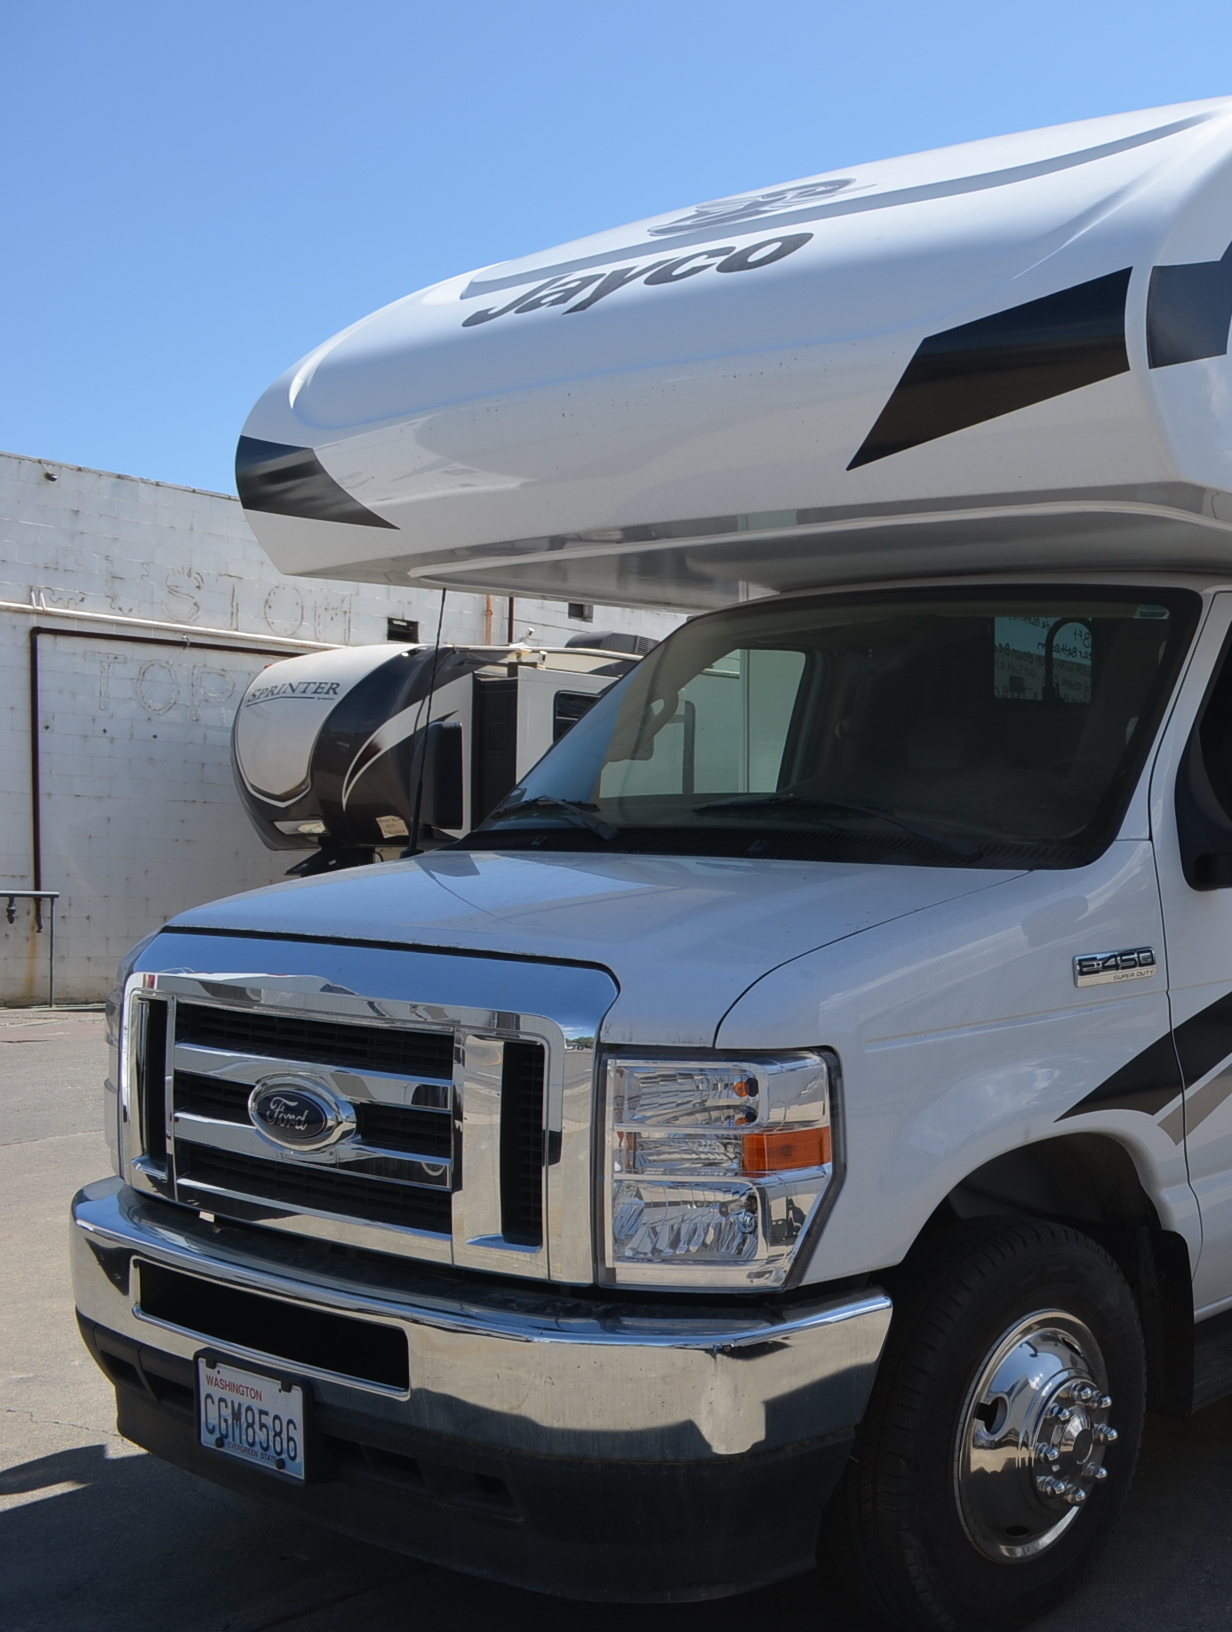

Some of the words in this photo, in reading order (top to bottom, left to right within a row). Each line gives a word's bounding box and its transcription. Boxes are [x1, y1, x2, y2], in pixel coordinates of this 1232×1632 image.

[461, 232, 814, 328] Jayco
[247, 681, 341, 702] SPRINTER
[1113, 972, 1135, 981] SUPER
[1136, 970, 1154, 978] DUTY
[266, 1096, 309, 1131] Ford
[206, 1374, 262, 1401] WASHINGTON
[204, 1393, 297, 1461] CGM8586
[227, 1441, 259, 1457] EVERGREEN
